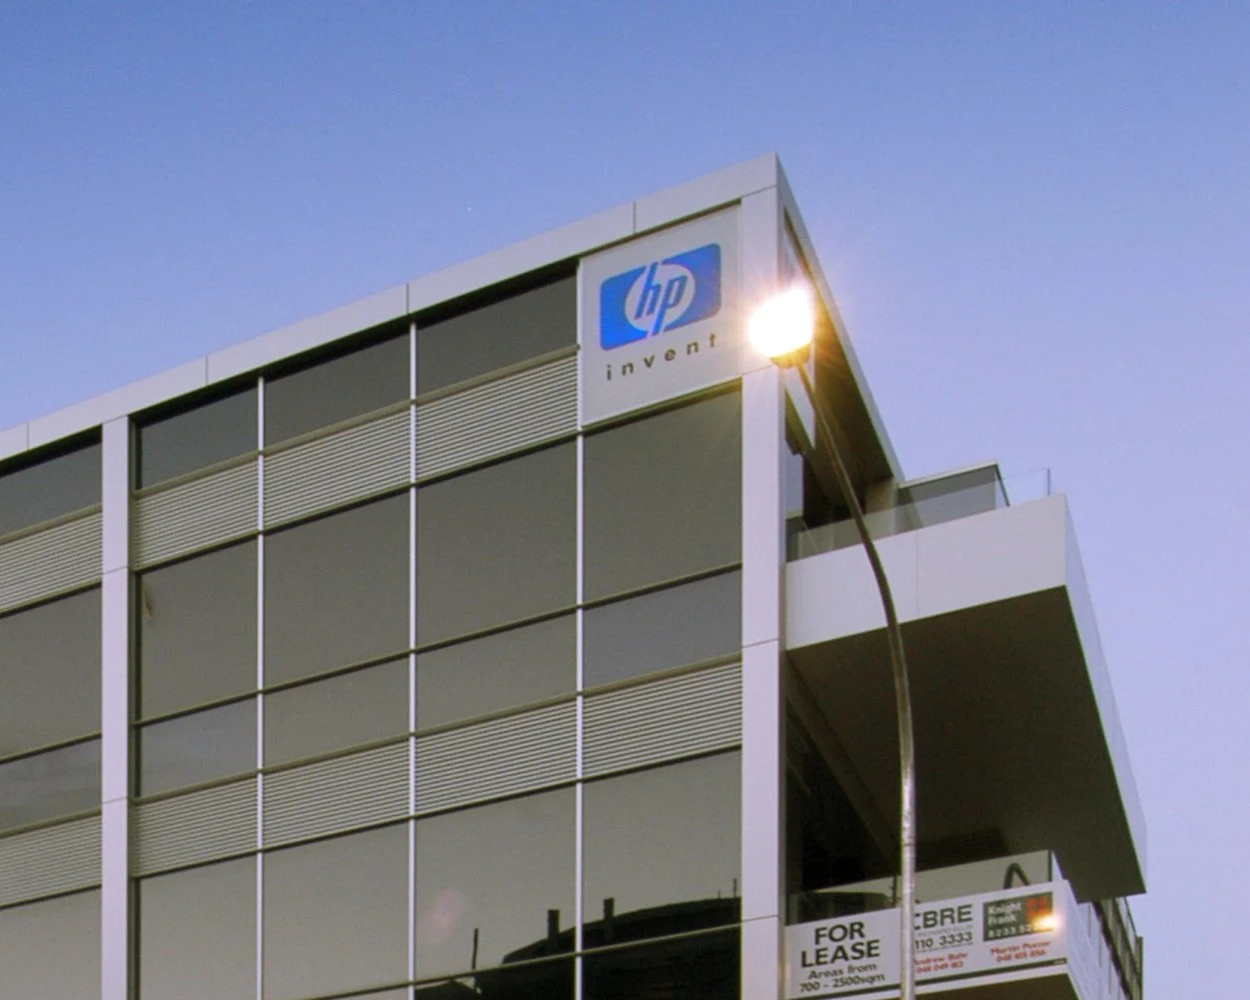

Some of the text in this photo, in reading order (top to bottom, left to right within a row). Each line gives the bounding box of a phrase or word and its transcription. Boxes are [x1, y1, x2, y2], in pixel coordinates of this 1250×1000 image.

[633, 261, 688, 336] hp
[606, 333, 716, 381] invent
[814, 921, 866, 945] FOR
[914, 938, 934, 950] 110
[939, 931, 972, 946] 3333
[801, 939, 880, 968] LEASE
[808, 964, 877, 980] Areas from
